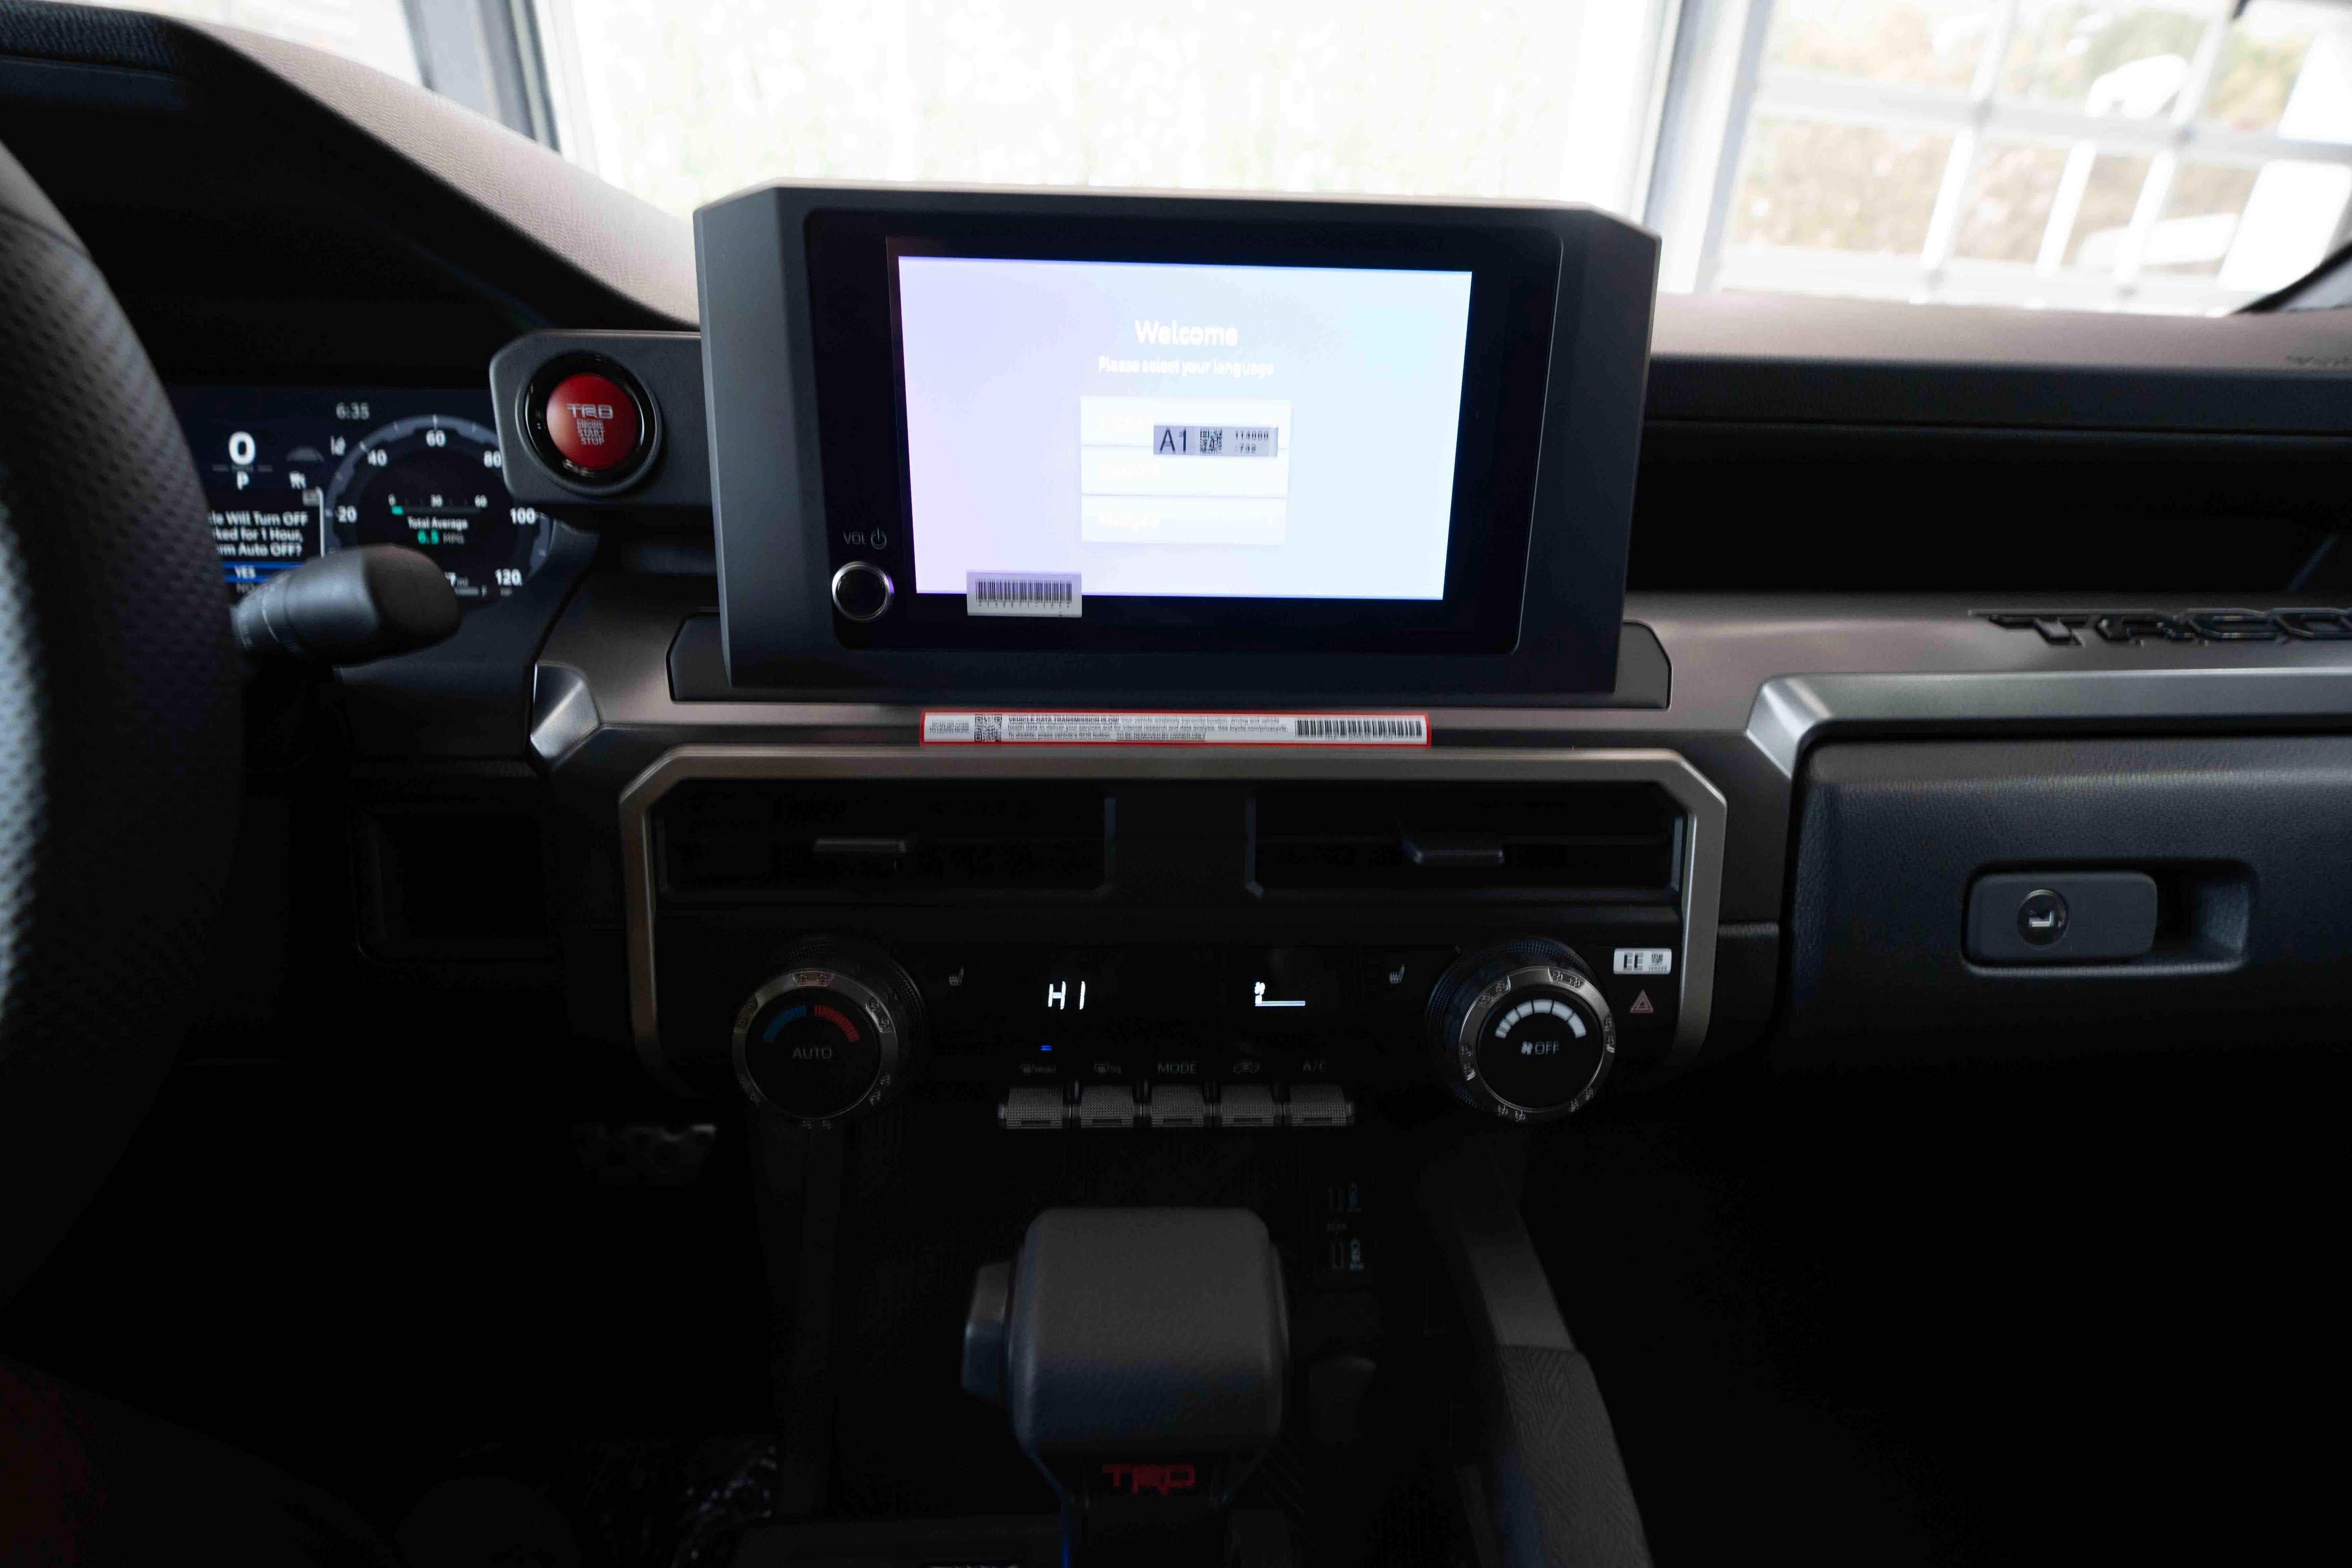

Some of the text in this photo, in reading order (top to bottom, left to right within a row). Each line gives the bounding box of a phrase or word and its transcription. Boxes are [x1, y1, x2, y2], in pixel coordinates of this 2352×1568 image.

[1134, 320, 1238, 346] Welcome
[1099, 355, 1273, 378] Please select your language
[336, 402, 370, 420] 6:35
[566, 403, 613, 419] TRD
[426, 430, 445, 447] 60
[581, 436, 604, 445] STOP
[1160, 427, 1186, 454] A1
[229, 431, 256, 465] 0
[368, 449, 388, 467] 40
[484, 450, 502, 468] 80
[237, 471, 249, 490] P
[226, 510, 251, 526] Will
[253, 511, 281, 526] Turn
[282, 511, 309, 527] OFF
[338, 506, 357, 523] 20
[510, 508, 536, 525] 100
[408, 516, 468, 532] Total Average
[240, 528, 259, 541] for
[843, 531, 866, 545] VOL
[238, 542, 270, 557] Auto
[270, 543, 303, 557] OFF?
[496, 568, 522, 587] 120
[1036, 715, 1051, 723] DATA
[1623, 952, 1644, 972] EE
[1048, 981, 1086, 1010] HI
[793, 1046, 832, 1060] AUTO
[1535, 1040, 1560, 1056] OFF
[1157, 1062, 1196, 1075] MODE
[1302, 1061, 1326, 1075] A/C
[1101, 1463, 1196, 1495] TRD
